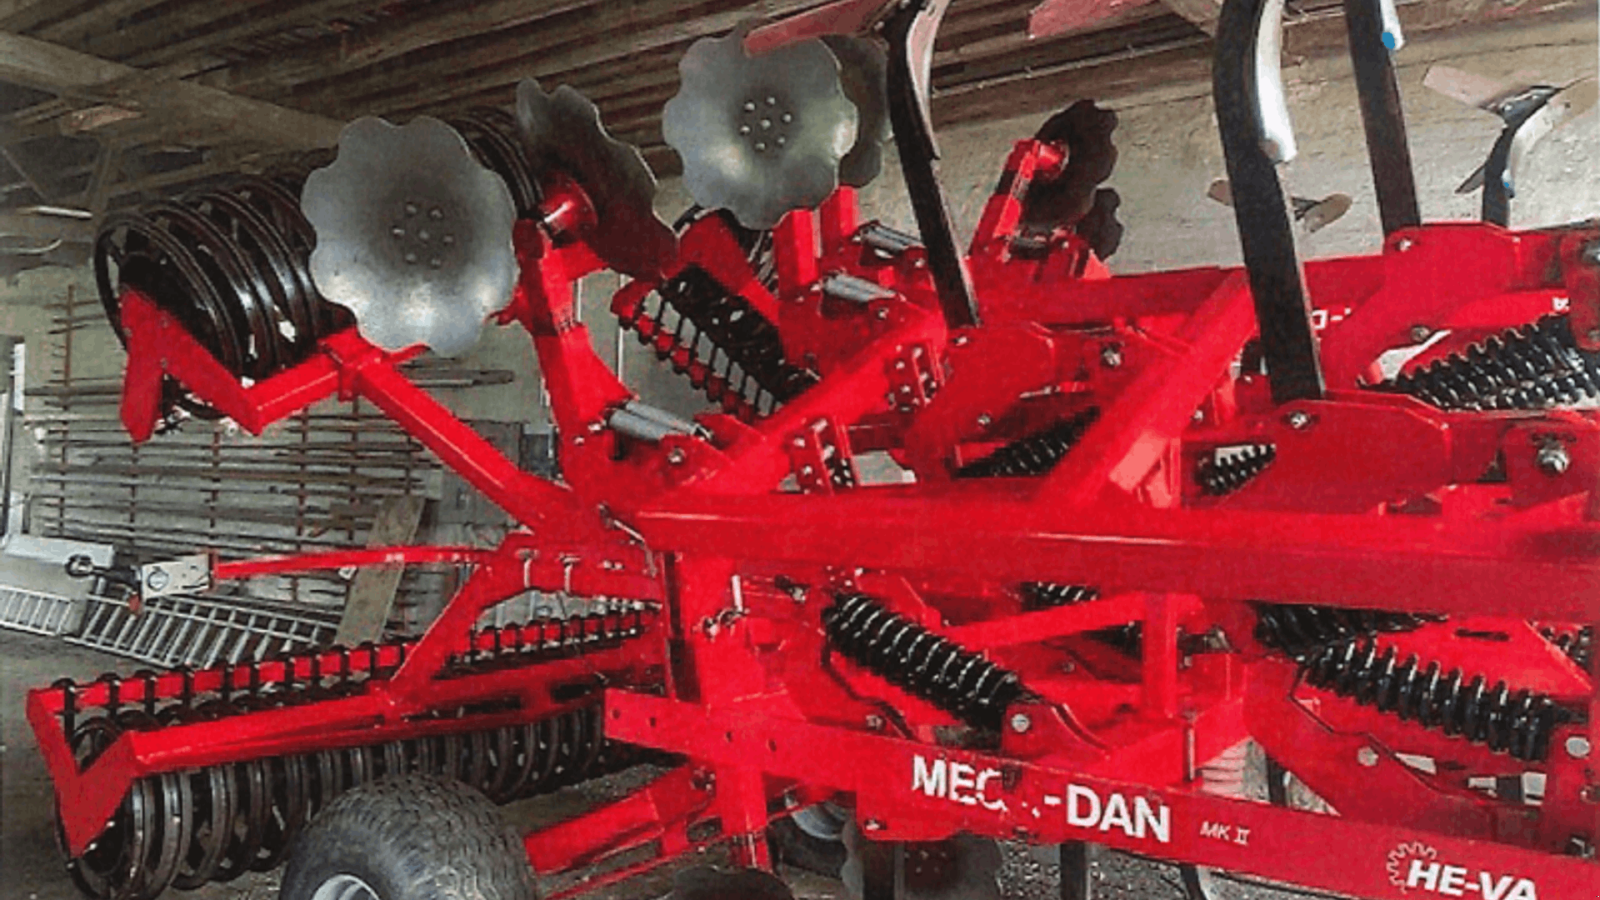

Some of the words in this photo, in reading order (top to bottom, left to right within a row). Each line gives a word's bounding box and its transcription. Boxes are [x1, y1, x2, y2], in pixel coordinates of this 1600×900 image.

[912, 755, 1170, 843] MEC-DAN
[1200, 820, 1231, 841] MK
[1407, 859, 1537, 900] HE-VA
